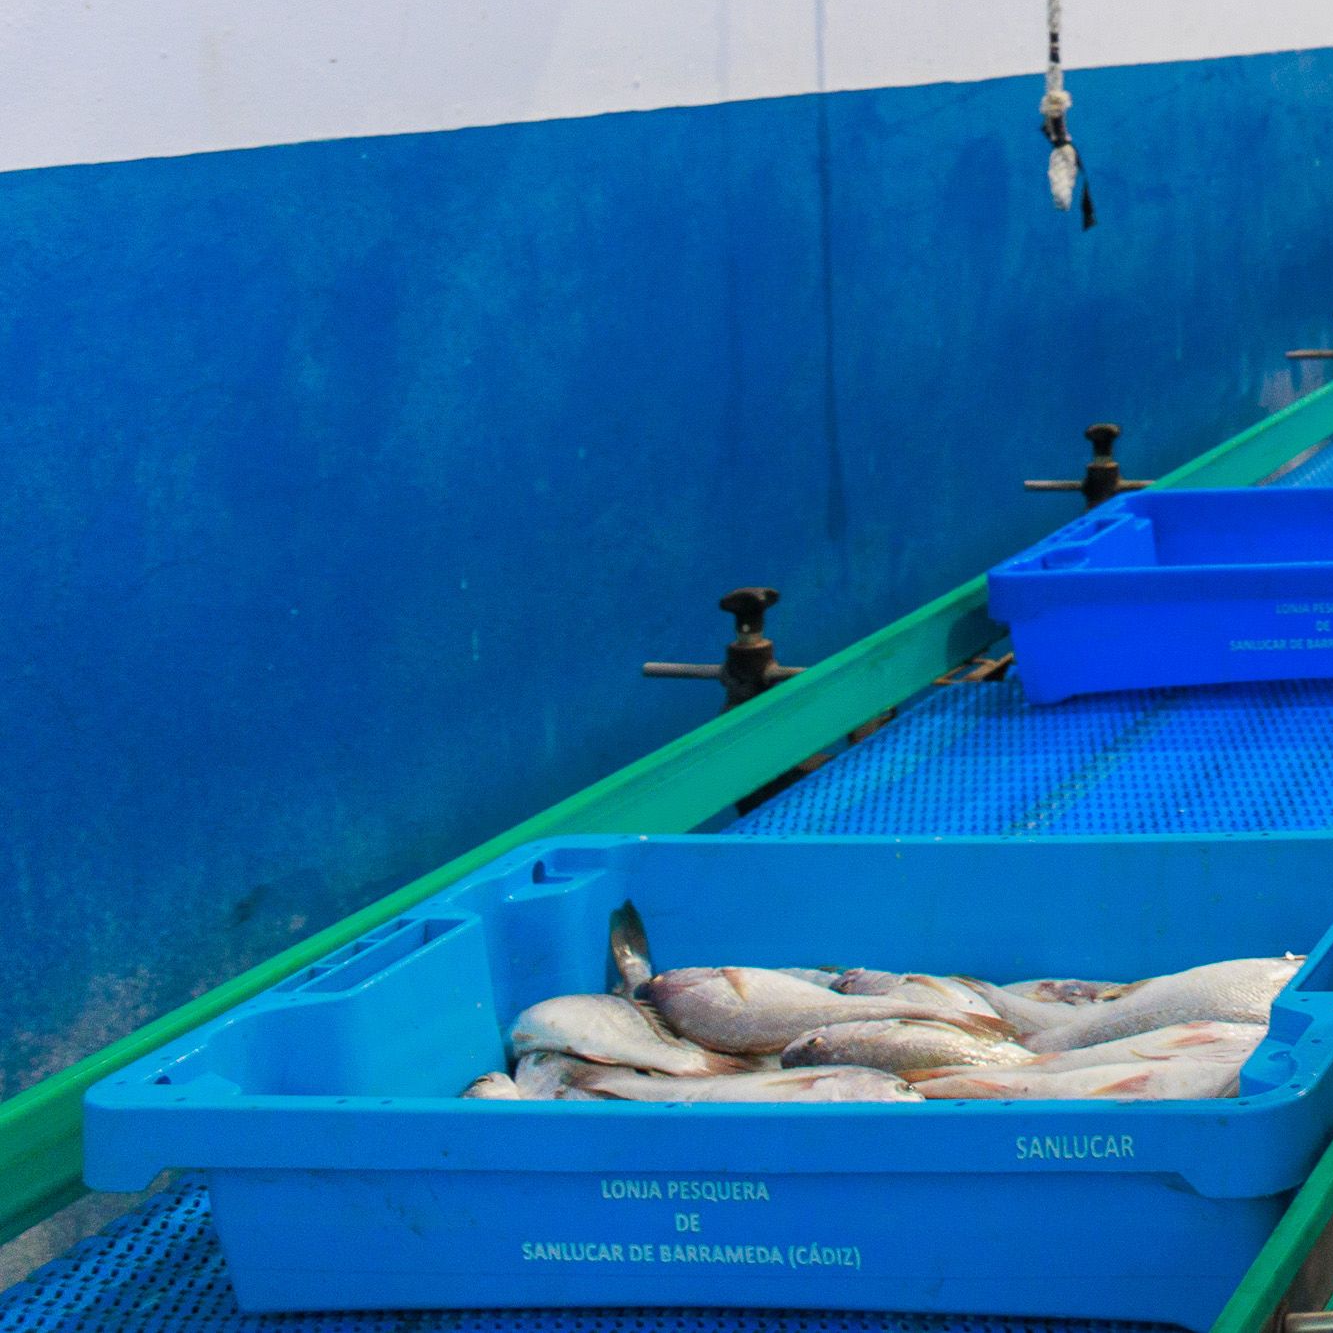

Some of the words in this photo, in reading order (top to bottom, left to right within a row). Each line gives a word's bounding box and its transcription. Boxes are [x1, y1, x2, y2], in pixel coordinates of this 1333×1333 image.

[1316, 620, 1330, 632] DE
[1016, 1134, 1135, 1159] SANLUCAR
[601, 1179, 661, 1200] LONJA
[668, 1180, 770, 1203] PESQUERA
[675, 1213, 700, 1232] DE
[522, 1242, 624, 1262] SANLUCAR
[630, 1244, 654, 1263] DE
[660, 1244, 783, 1266] BARRAMEDA
[788, 1243, 861, 1269] (CÁDIZ)
